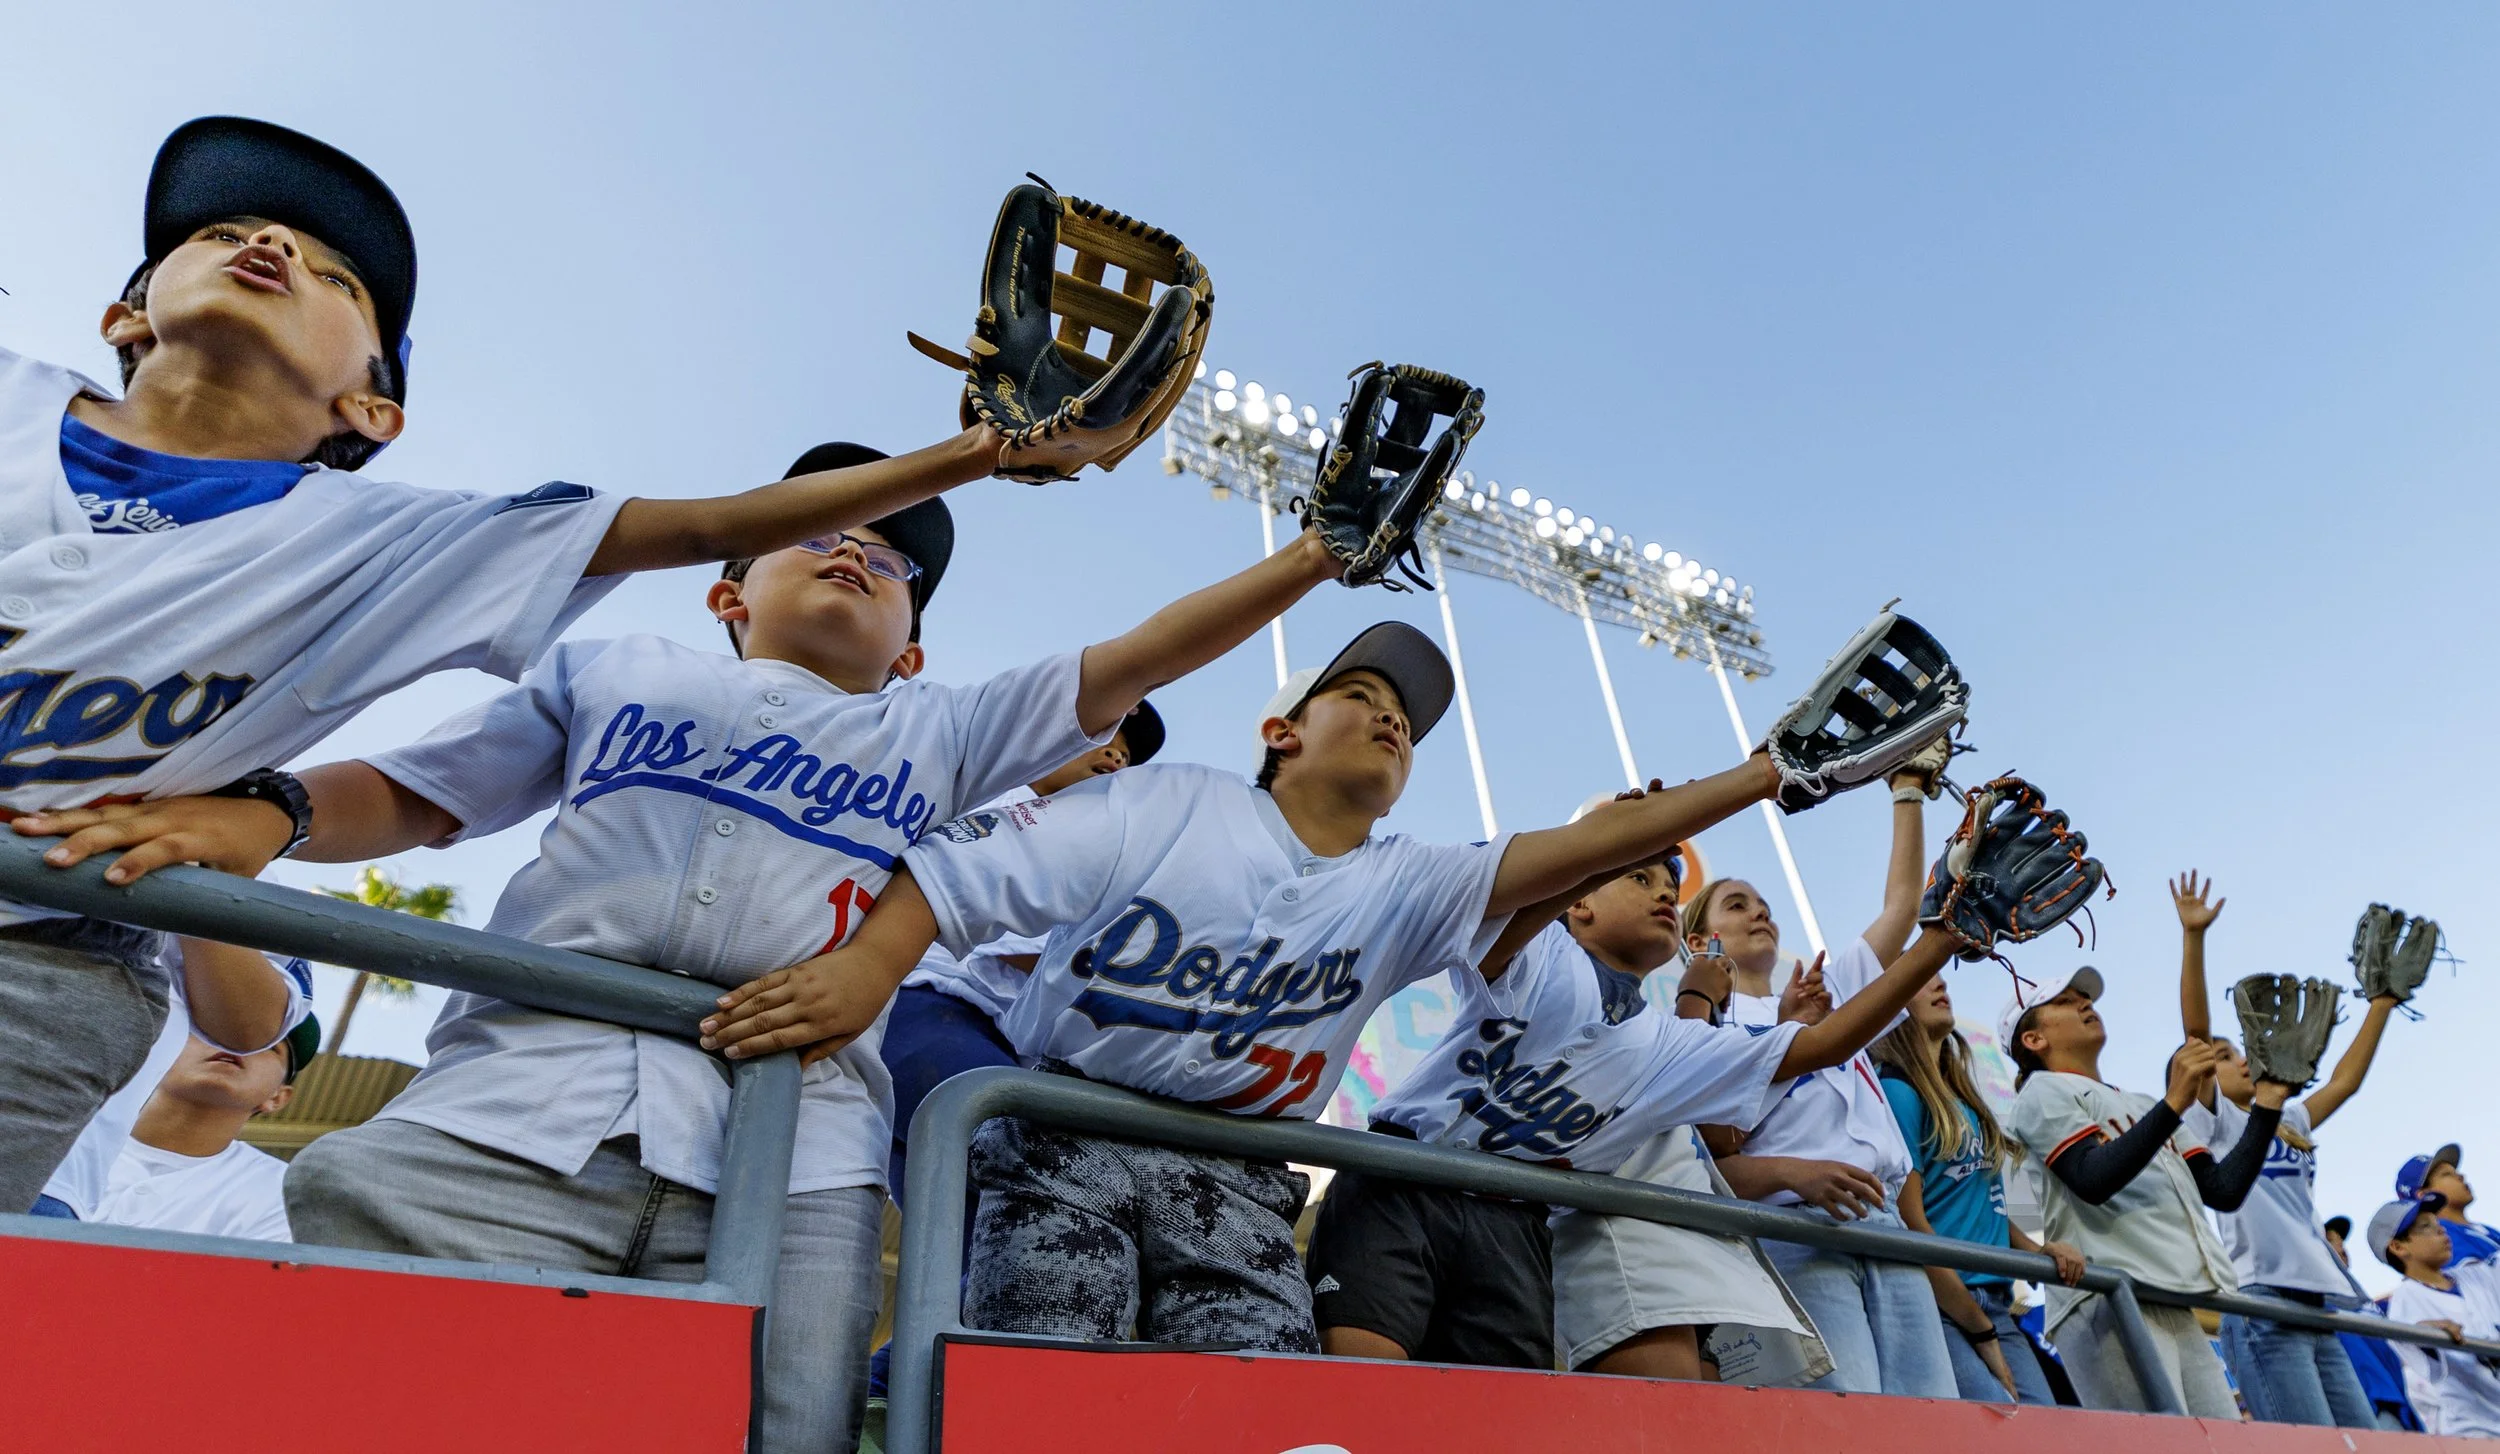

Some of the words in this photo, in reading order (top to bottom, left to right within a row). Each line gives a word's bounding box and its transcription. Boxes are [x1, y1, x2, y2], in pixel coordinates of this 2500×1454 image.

[579, 703, 707, 785] Los
[1071, 895, 1364, 1061] Dodgers
[1208, 1043, 1328, 1119] 72
